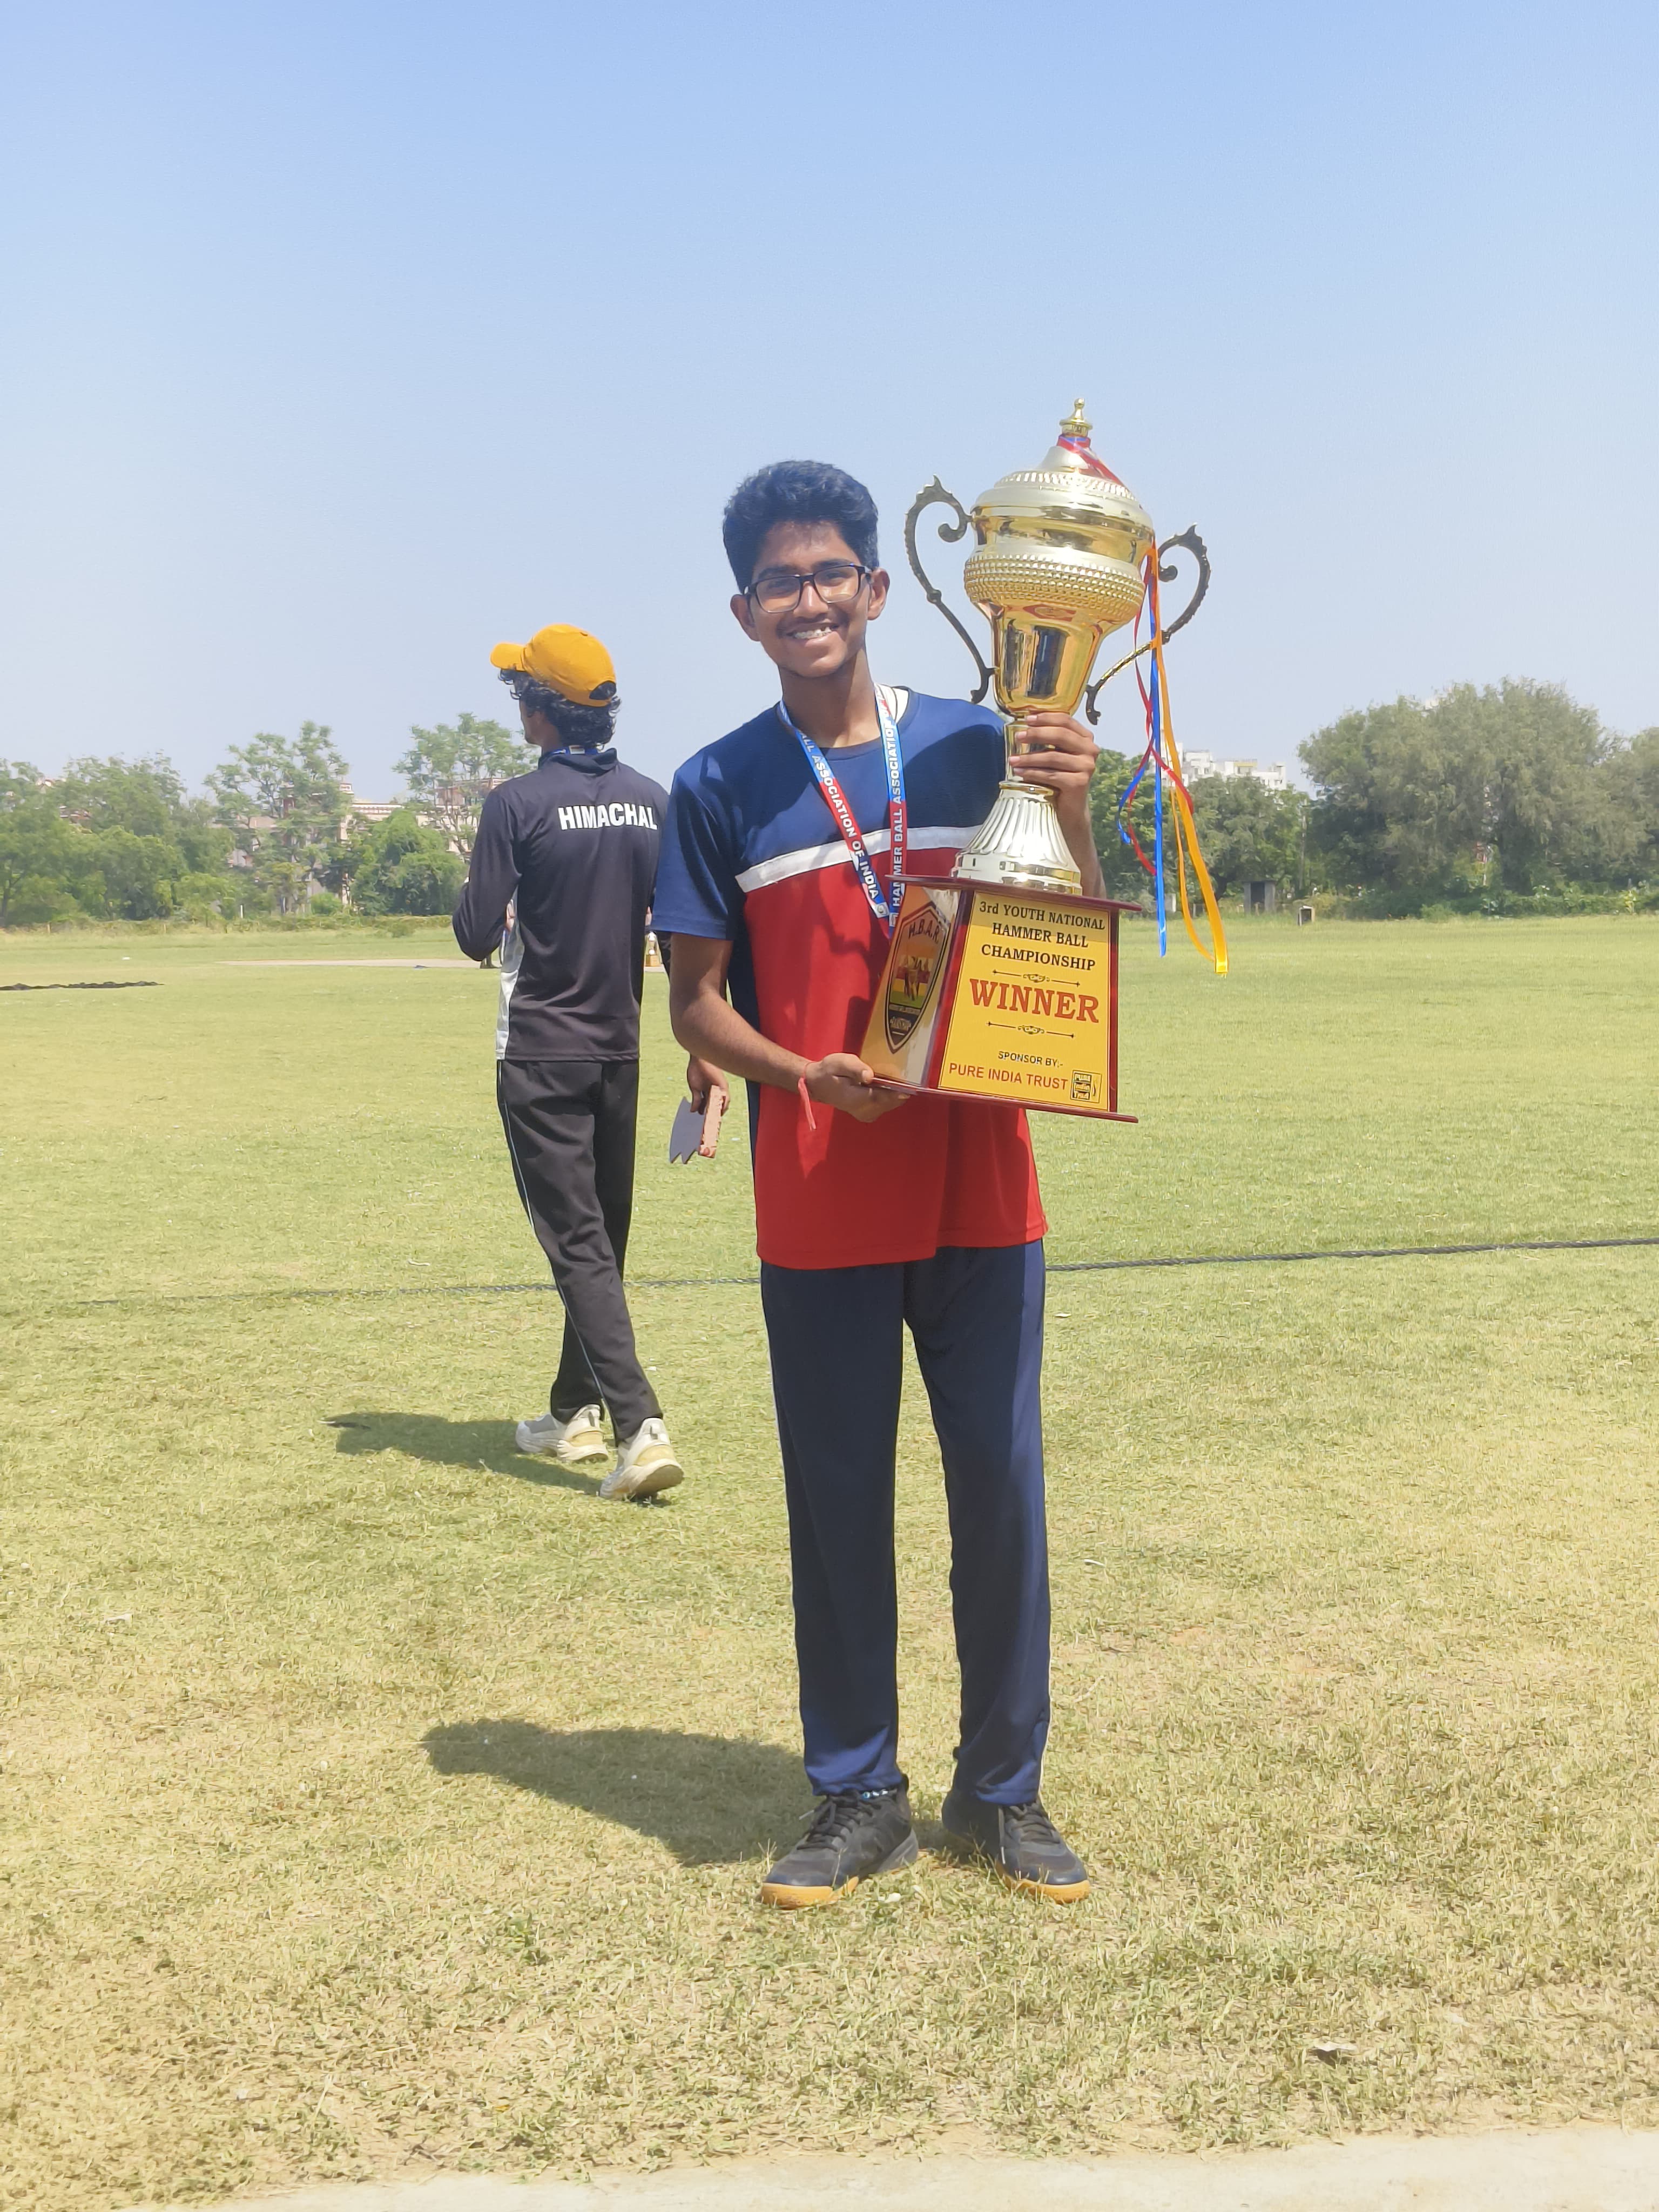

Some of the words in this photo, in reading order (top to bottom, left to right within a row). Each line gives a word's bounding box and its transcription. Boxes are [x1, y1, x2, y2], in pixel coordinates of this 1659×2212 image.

[558, 802, 658, 831] HIMACHAL
[812, 754, 857, 838] ASSOCIATION
[852, 840, 865, 858] OF
[860, 861, 879, 899] INDIA
[893, 808, 903, 842] BALL
[979, 901, 999, 914] 3rd
[1003, 904, 1046, 921] YOUTH
[1048, 912, 1105, 930] NATIONAL
[992, 922, 1052, 943] HAMMER
[1056, 932, 1089, 948] BALL
[981, 944, 1096, 971] CHAMPIONSHIP
[969, 978, 1100, 1023] WINNER
[997, 1051, 1043, 1065] SPONSOR
[949, 1062, 984, 1078] PURE
[988, 1068, 1022, 1084] INDIA
[1026, 1074, 1069, 1090] TRUST
